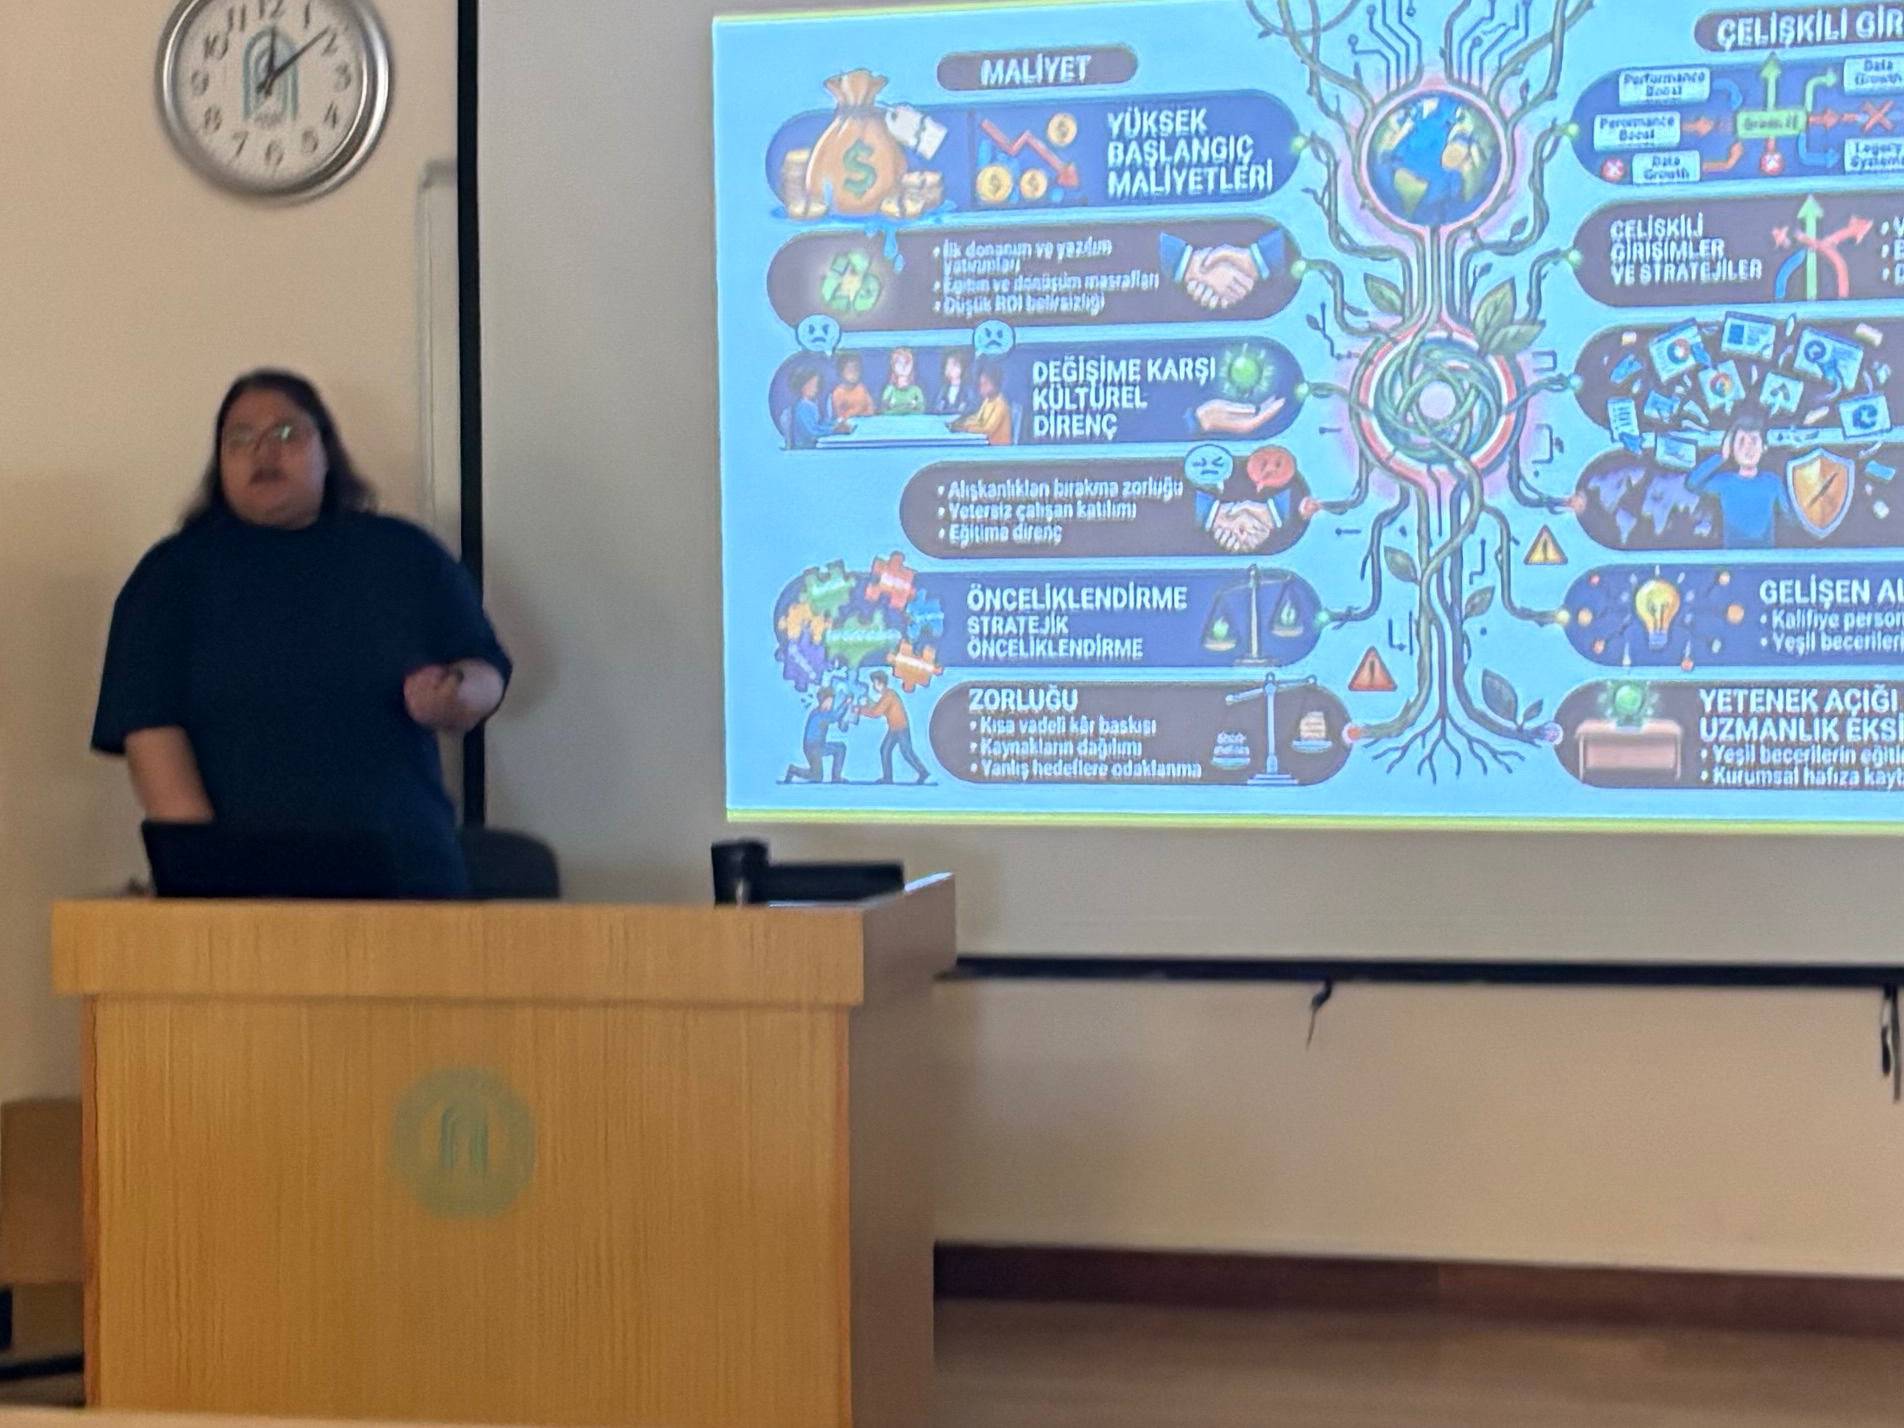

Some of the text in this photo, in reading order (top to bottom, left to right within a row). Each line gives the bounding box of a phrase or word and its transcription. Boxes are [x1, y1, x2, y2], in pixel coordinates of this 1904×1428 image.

[1717, 7, 1848, 50] ÇELİŞKİLİ
[980, 52, 1093, 86] MALİYET
[1107, 106, 1207, 136] YÜKSEK
[1107, 134, 1254, 168] BAŞLANGIÇ
[1107, 158, 1272, 199] MALİYETLERİ
[1611, 258, 1762, 285] VE STRATEJİLER
[1033, 355, 1216, 386] DEĞİŞİME KARŞI
[1033, 383, 1148, 411] KÜLTÜREL
[1034, 410, 1118, 441] DİRENÇ
[967, 581, 1187, 612] ÖNCELİKLENDİRME
[1759, 574, 1870, 610] GELİŞEN
[967, 613, 1069, 636] STRATEJİK
[967, 633, 1143, 660] ÖNCELİKLENDİRME
[1773, 631, 1815, 656] Yeşil
[969, 684, 1078, 712] ZORLUĞU
[1699, 687, 1818, 713] YETENEK
[1824, 684, 1898, 717] AÇIĞI
[1700, 717, 1839, 743] UZMANLIK
[1713, 766, 1798, 786] Kurumsal
